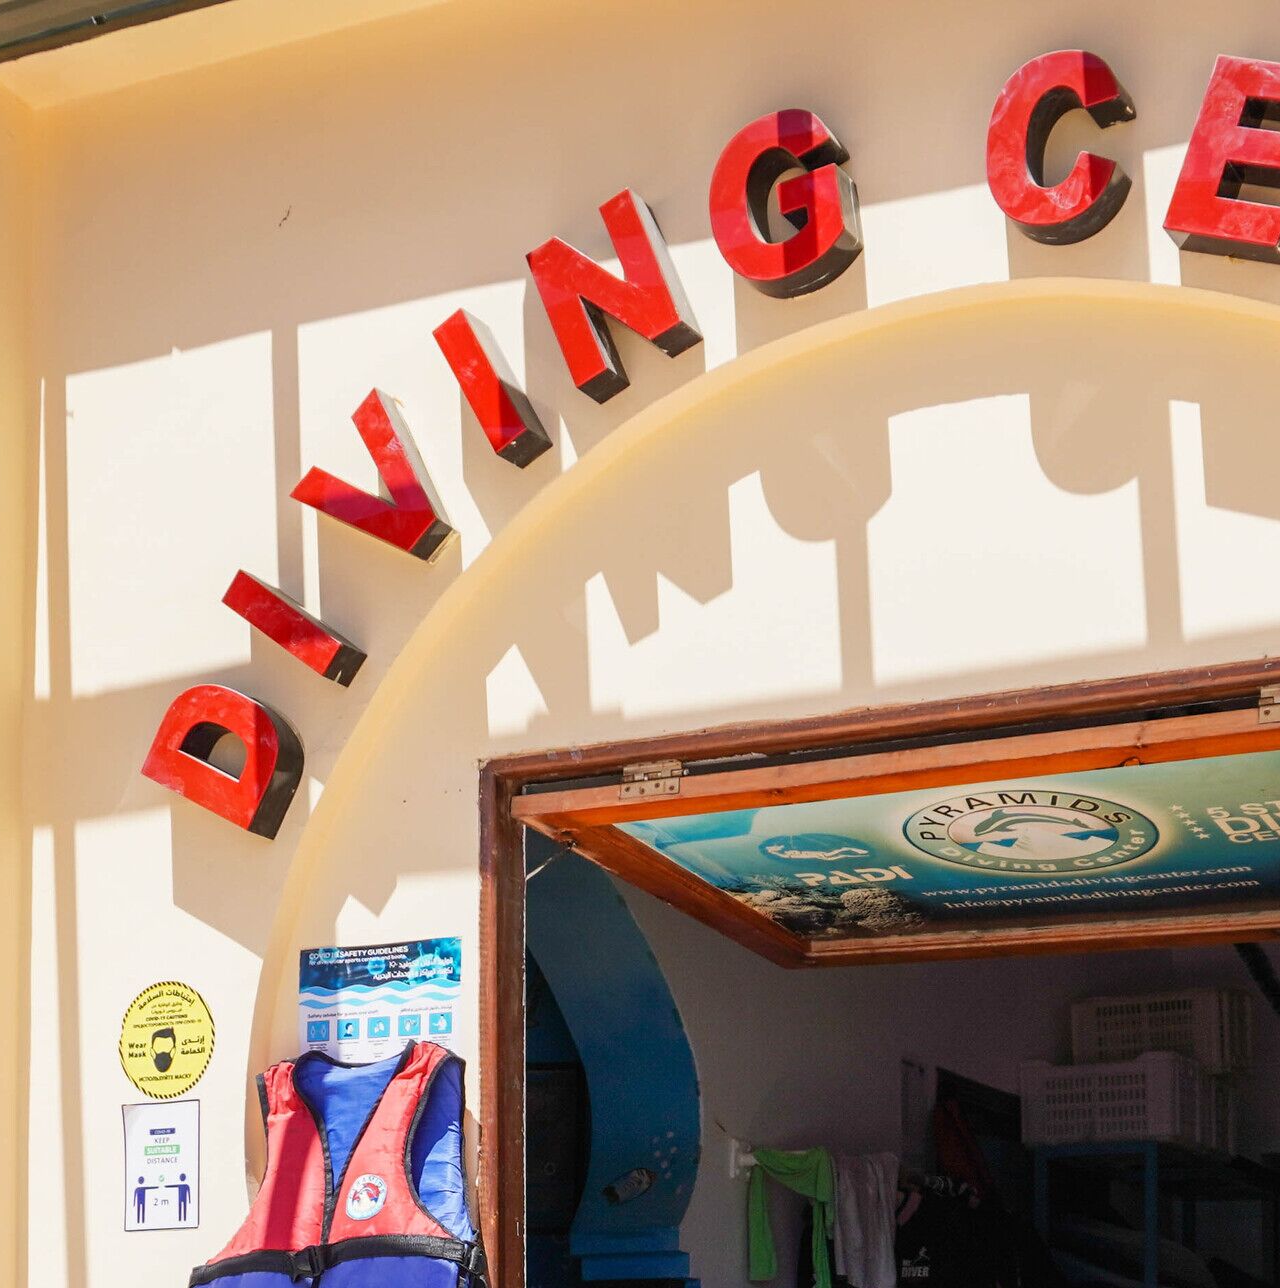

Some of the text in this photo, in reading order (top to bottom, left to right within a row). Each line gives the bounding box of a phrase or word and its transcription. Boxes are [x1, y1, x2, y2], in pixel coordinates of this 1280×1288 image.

[142, 109, 863, 839] DIVING
[919, 793, 1132, 842] PYRAMIDS
[1206, 807, 1230, 819] 5
[939, 828, 1145, 871] Diving Center
[795, 864, 914, 886] PADI
[921, 863, 1253, 898] www.pyramidsdivingcenter.com
[944, 878, 1260, 910] Info@pyramidsdivingcenter.com
[340, 949, 367, 957] SAFETY
[367, 945, 408, 955] GUIDELINES
[153, 1198, 159, 1206] 2
[901, 1266, 929, 1278] DIVER
